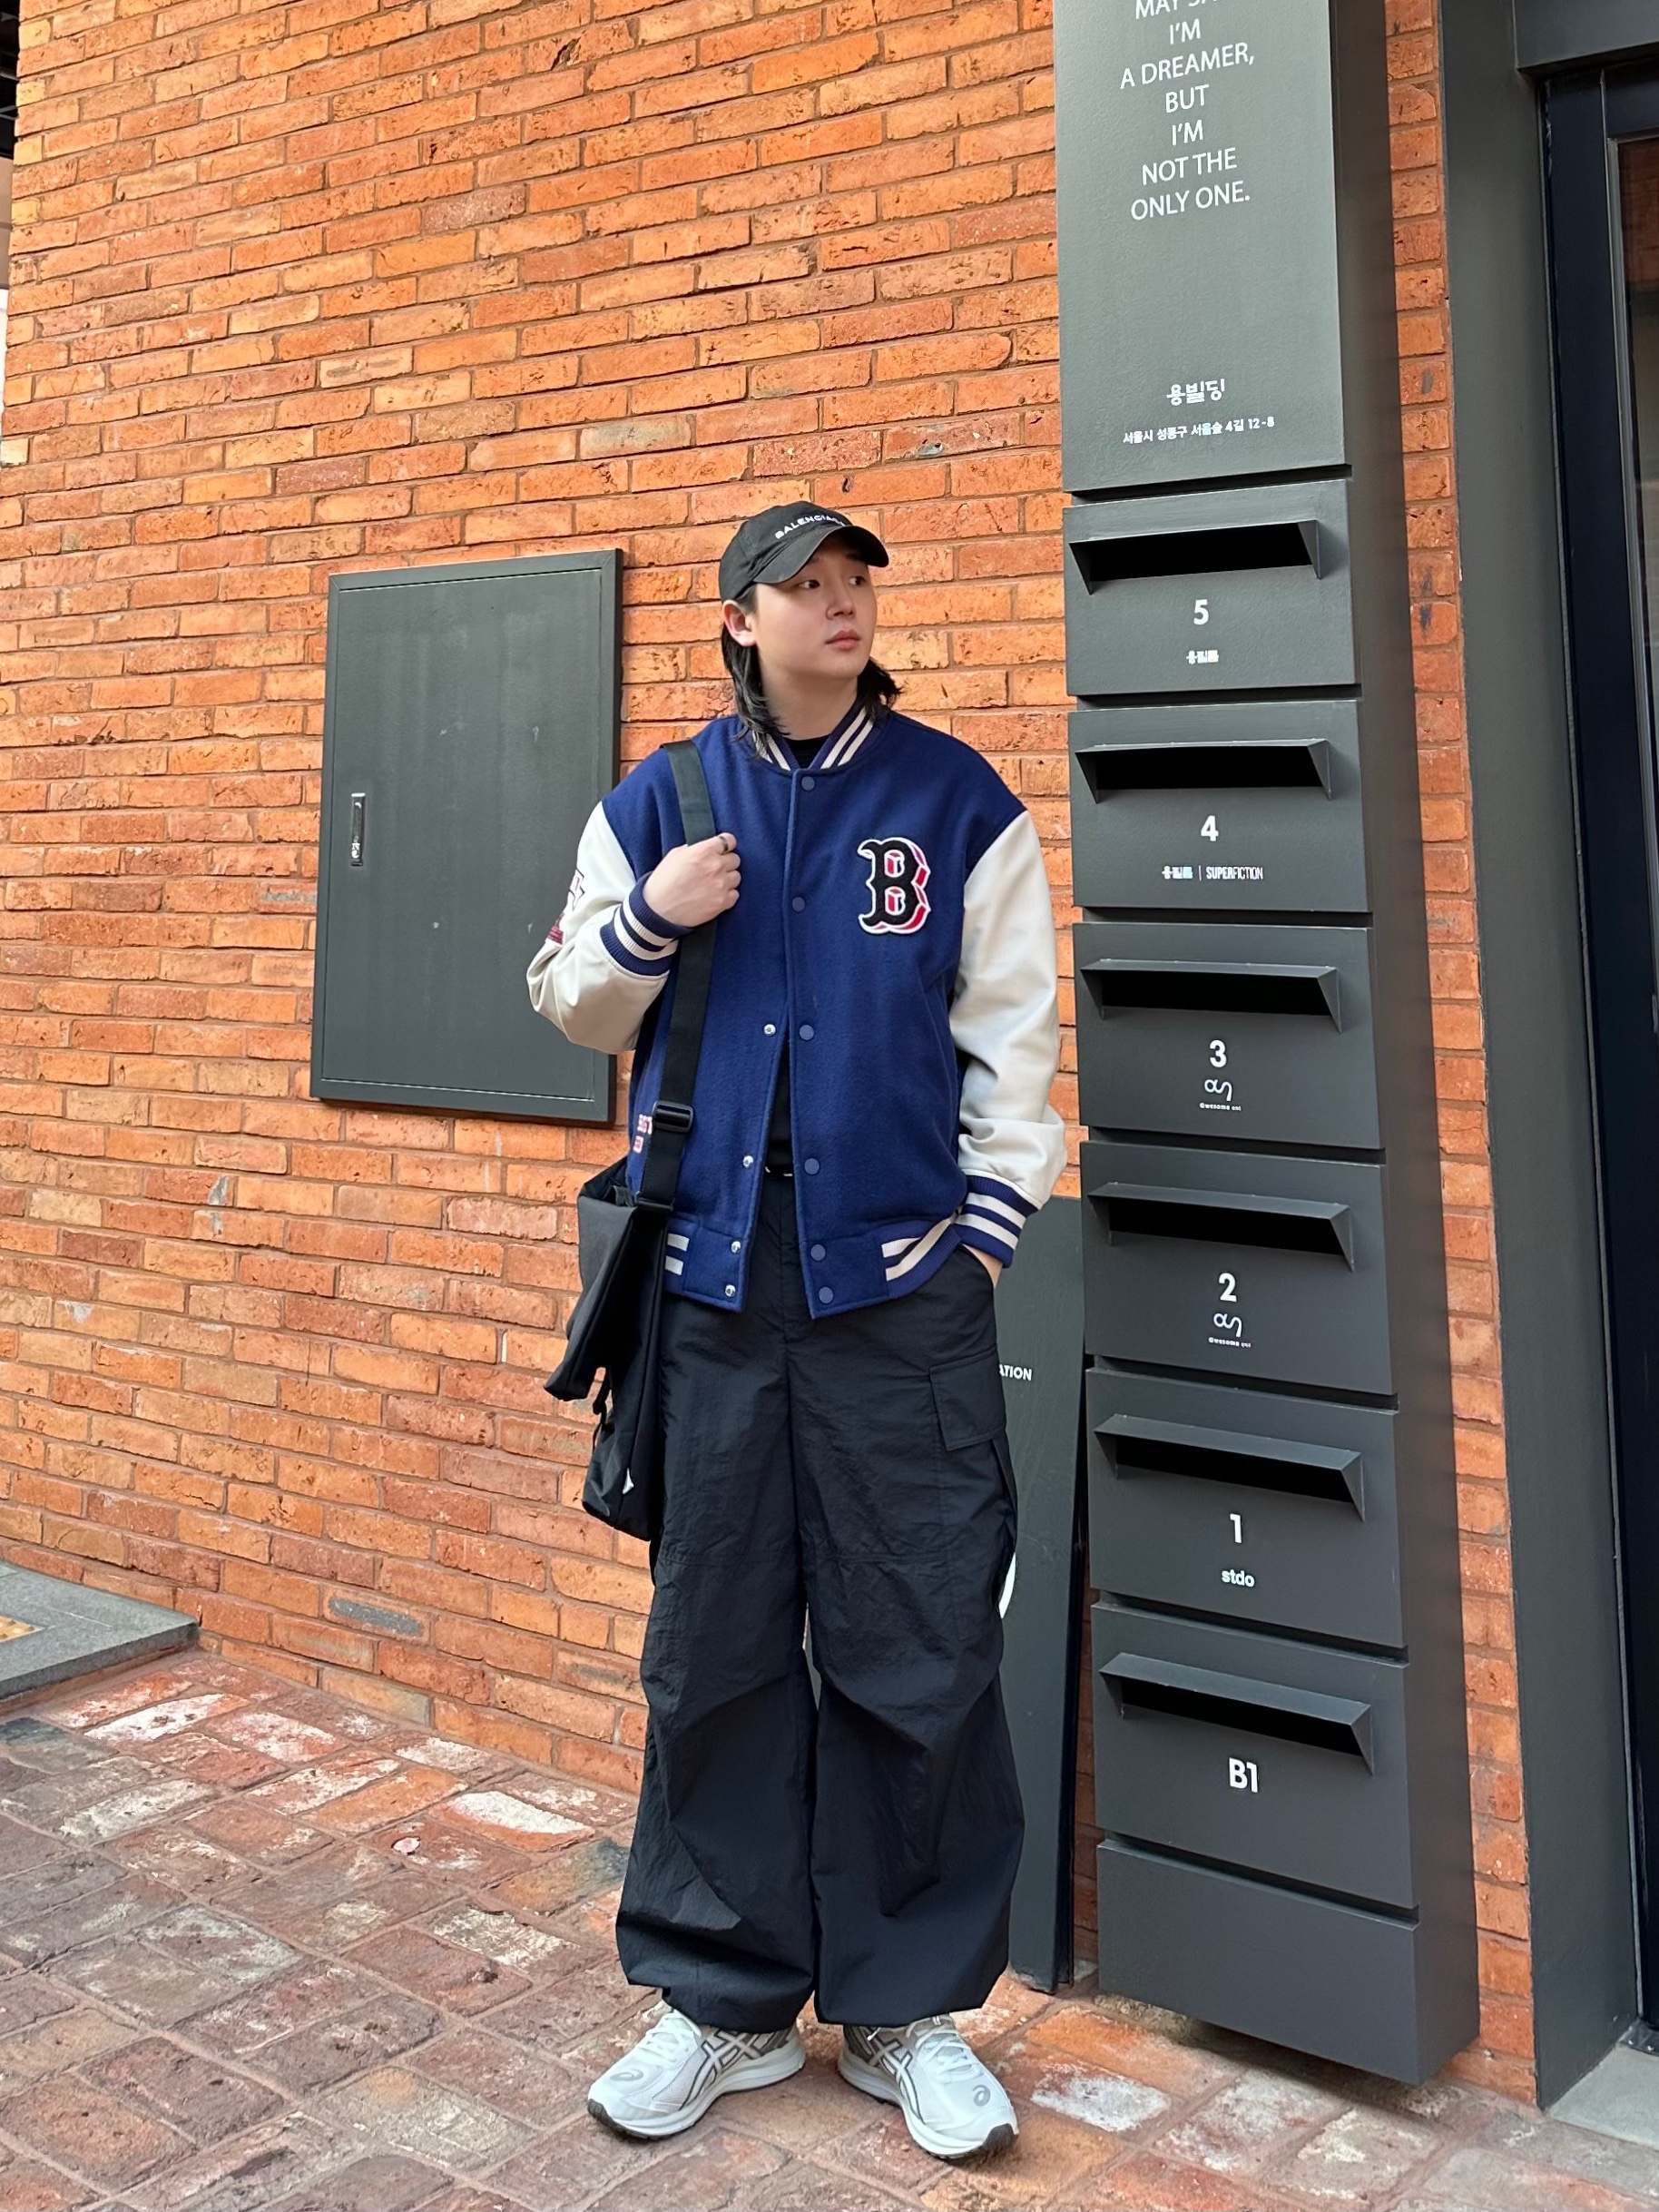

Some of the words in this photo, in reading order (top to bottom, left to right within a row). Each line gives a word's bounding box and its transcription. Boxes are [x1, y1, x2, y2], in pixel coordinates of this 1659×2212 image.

[1169, 18, 1201, 45] I'M
[1120, 67, 1135, 90] A
[1141, 41, 1254, 85] DREAMER,
[1165, 84, 1210, 113] BUT
[1172, 119, 1203, 147] I'M
[1142, 155, 1189, 186] NOT
[1192, 147, 1238, 176] THE
[1130, 190, 1190, 221] ONLY
[1195, 180, 1251, 209] ONE.
[1166, 378, 1225, 407] 용빌딩
[1122, 428, 1153, 445] 서울시
[1156, 426, 1188, 441] 성동구
[1224, 418, 1244, 432] 4길
[1193, 598, 1210, 625] 5
[1201, 815, 1219, 842] 4
[857, 837, 931, 934] B
[1205, 866, 1263, 880] SUPERFICTION
[1209, 1039, 1227, 1068] 3
[1218, 1273, 1237, 1303] 2
[1230, 1513, 1242, 1544] 1
[1222, 1568, 1255, 1588] stdo
[1229, 1757, 1258, 1793] B1
